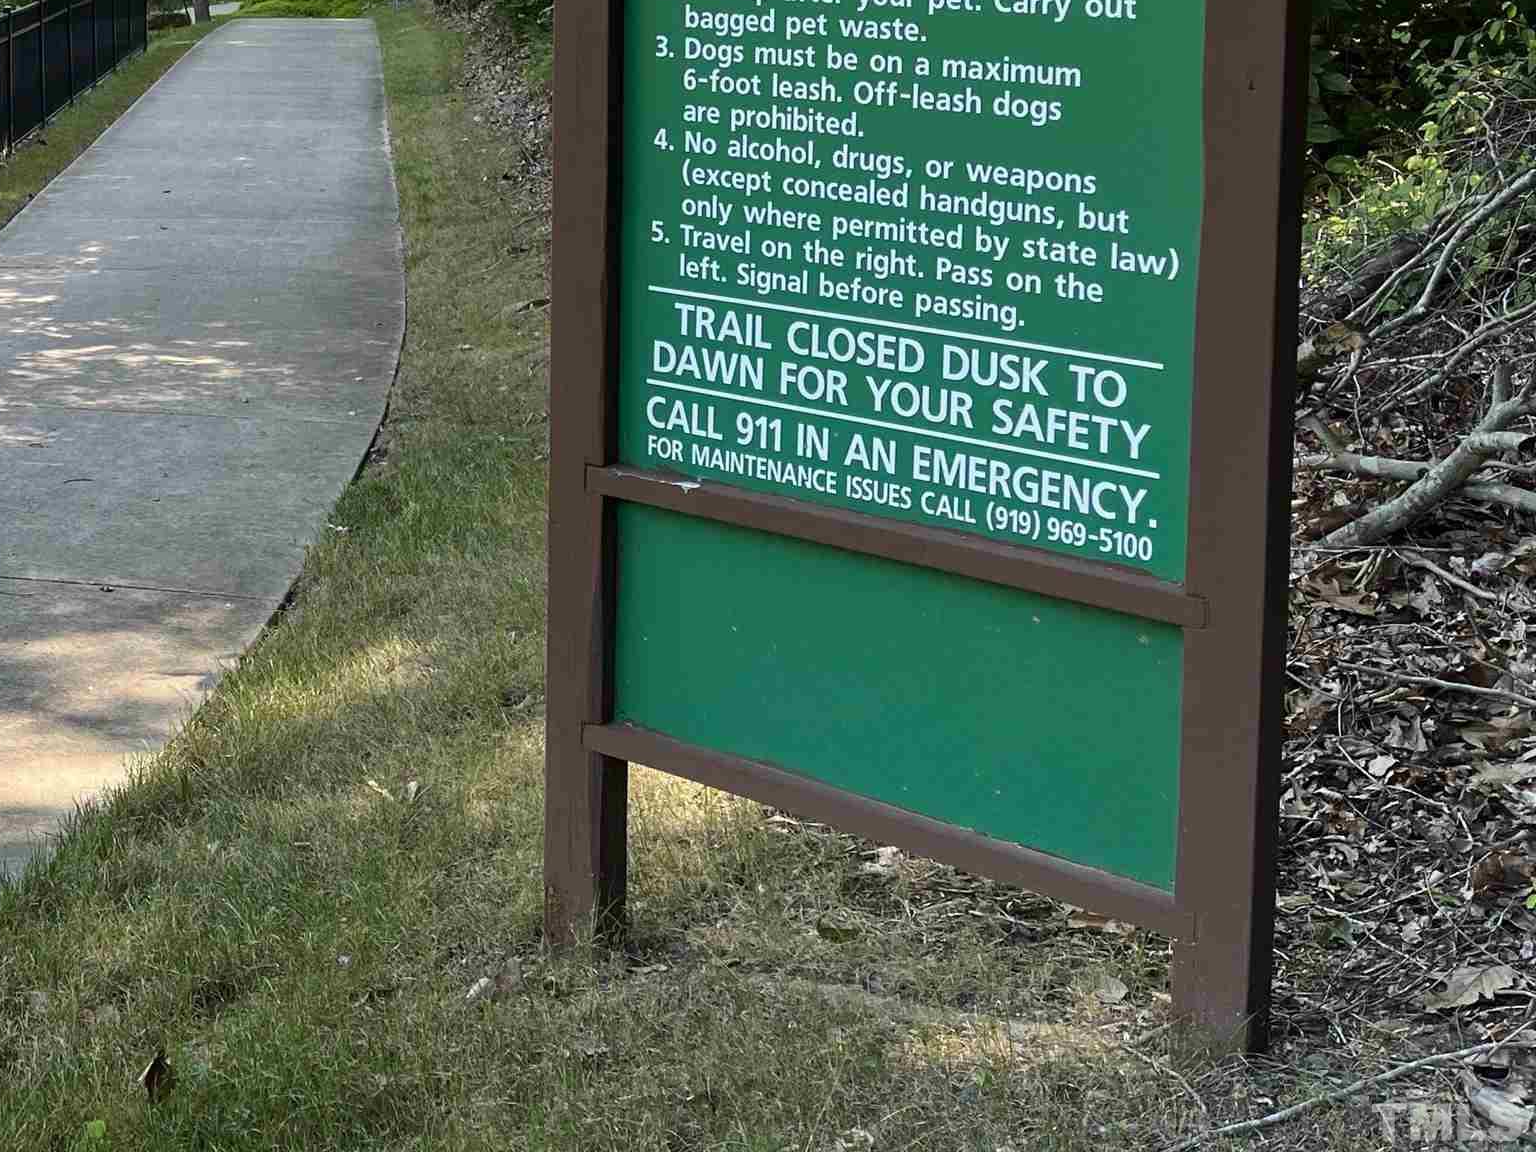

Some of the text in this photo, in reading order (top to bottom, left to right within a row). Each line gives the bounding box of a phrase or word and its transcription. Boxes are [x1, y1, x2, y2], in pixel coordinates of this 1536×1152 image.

[655, 35, 1081, 87] 3. Dogs must be on a maximum
[684, 3, 927, 42] bagged pet waste.
[683, 68, 1062, 127] 6-foot leash. Off-leash dogs
[683, 104, 864, 137] are prohibited.
[653, 127, 1097, 195] 4. No alcohol, drugs, or weapons
[682, 158, 1129, 234] (except concealed handguns, but
[651, 220, 1104, 303] 5. Travel on the right. Pass on the
[681, 194, 1180, 281] only where permitted by state law)
[679, 252, 1025, 332] left. Signal before passing.
[674, 302, 1127, 408] TRAIL CLOSED DUSK TO
[653, 339, 1152, 460] DAWN FOR YOUR SAFETY
[646, 395, 1157, 529] CALL 911 IN AN EMERGENCY.
[647, 434, 1153, 561] FOR MAINTENANCE ISSUES CALL (919) 969-5100
